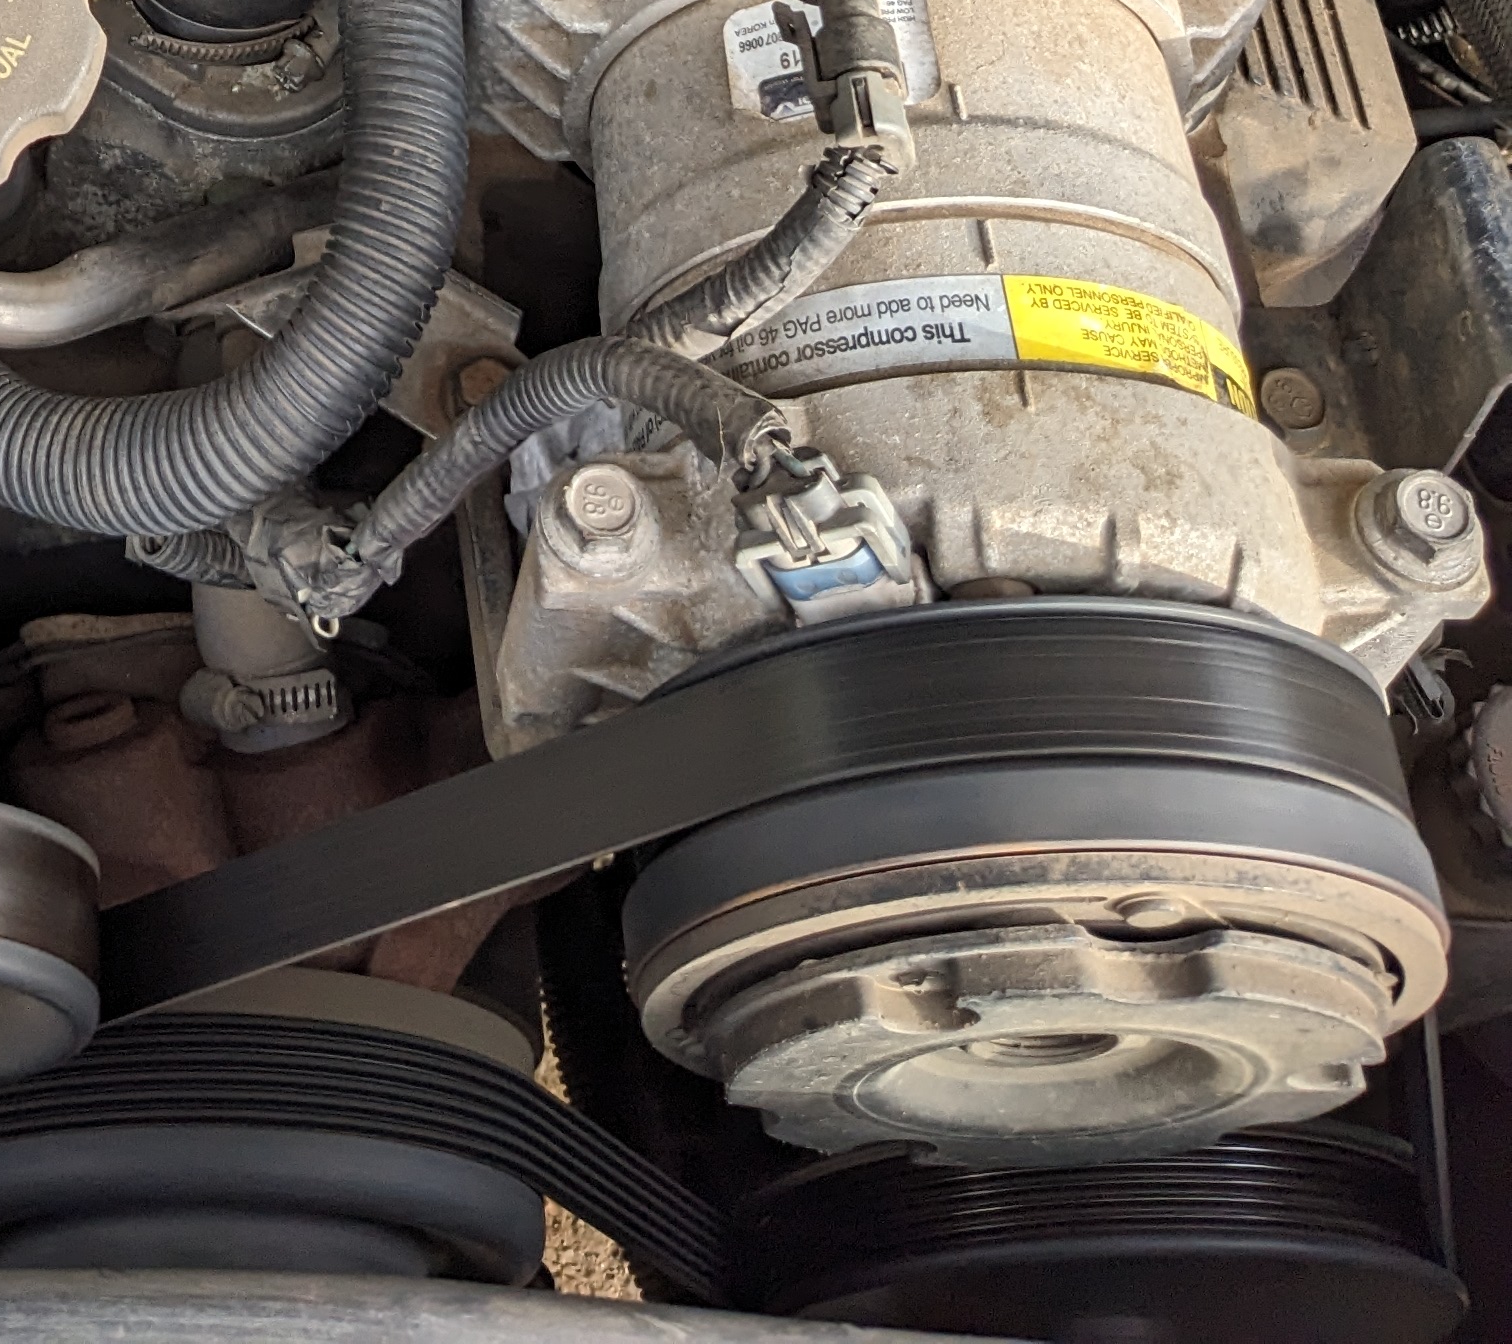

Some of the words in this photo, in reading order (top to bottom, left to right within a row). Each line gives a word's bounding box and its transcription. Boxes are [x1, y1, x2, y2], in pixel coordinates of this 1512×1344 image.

[734, 20, 768, 38] KOREA
[1021, 282, 1064, 296] ONLY.
[1065, 286, 1146, 310] PERSONNEL
[876, 297, 912, 315] add
[916, 296, 936, 313] to
[939, 293, 992, 313] Need
[1030, 296, 1050, 309] BY
[1052, 298, 1120, 318] SERVICED
[826, 302, 872, 325] more
[1125, 309, 1144, 321] BE
[784, 312, 822, 340] PAG
[924, 321, 971, 344] This
[759, 326, 780, 347] 46
[793, 323, 918, 363] compressor
[1081, 328, 1126, 346] CAUSE
[1129, 337, 1159, 351] MAY
[1103, 344, 1161, 363] SERVICE
